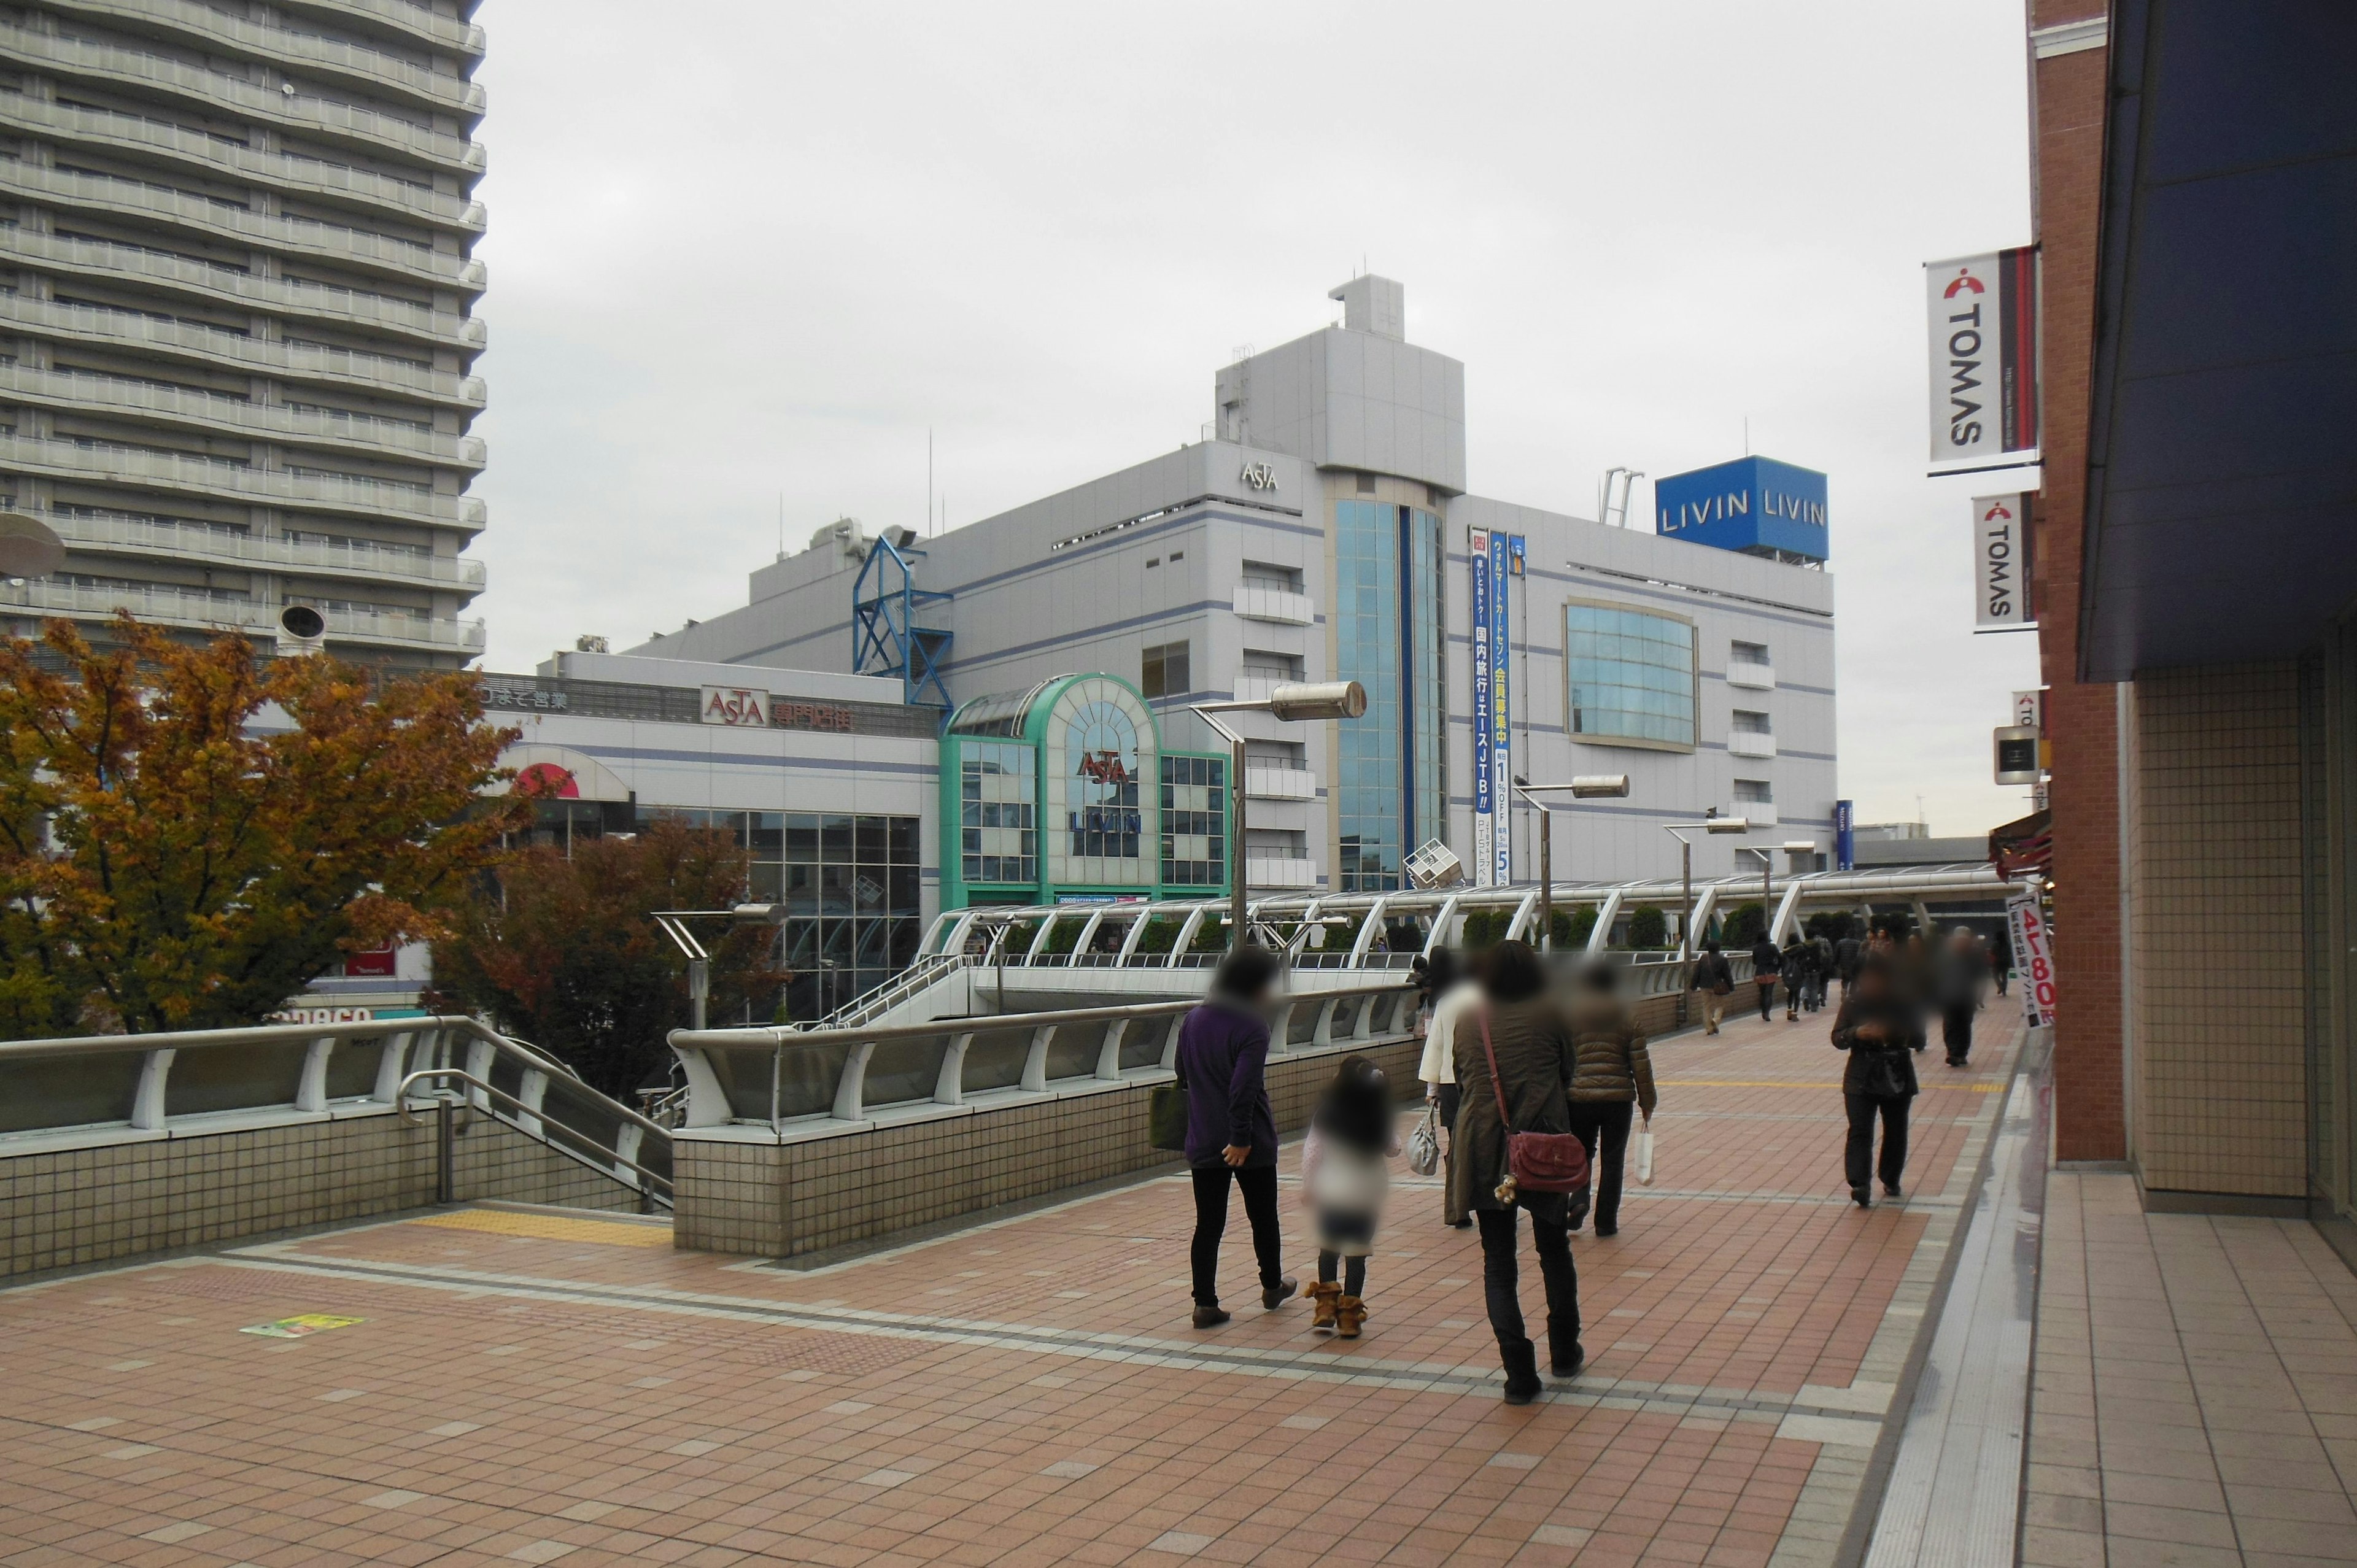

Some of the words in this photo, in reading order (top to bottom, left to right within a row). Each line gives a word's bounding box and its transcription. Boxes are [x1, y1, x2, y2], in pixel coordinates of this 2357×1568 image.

[1949, 303, 1982, 446] TOMAS
[1242, 462, 1279, 490] ASTA
[1662, 490, 1749, 532] LIVIN
[1763, 489, 1825, 527] LIVIN
[1988, 525, 2011, 616] TOMAS
[705, 690, 764, 725] ASTA
[774, 703, 853, 729] 専門店街
[1077, 750, 1129, 784] ASTA
[1069, 811, 1141, 834] LIVIN
